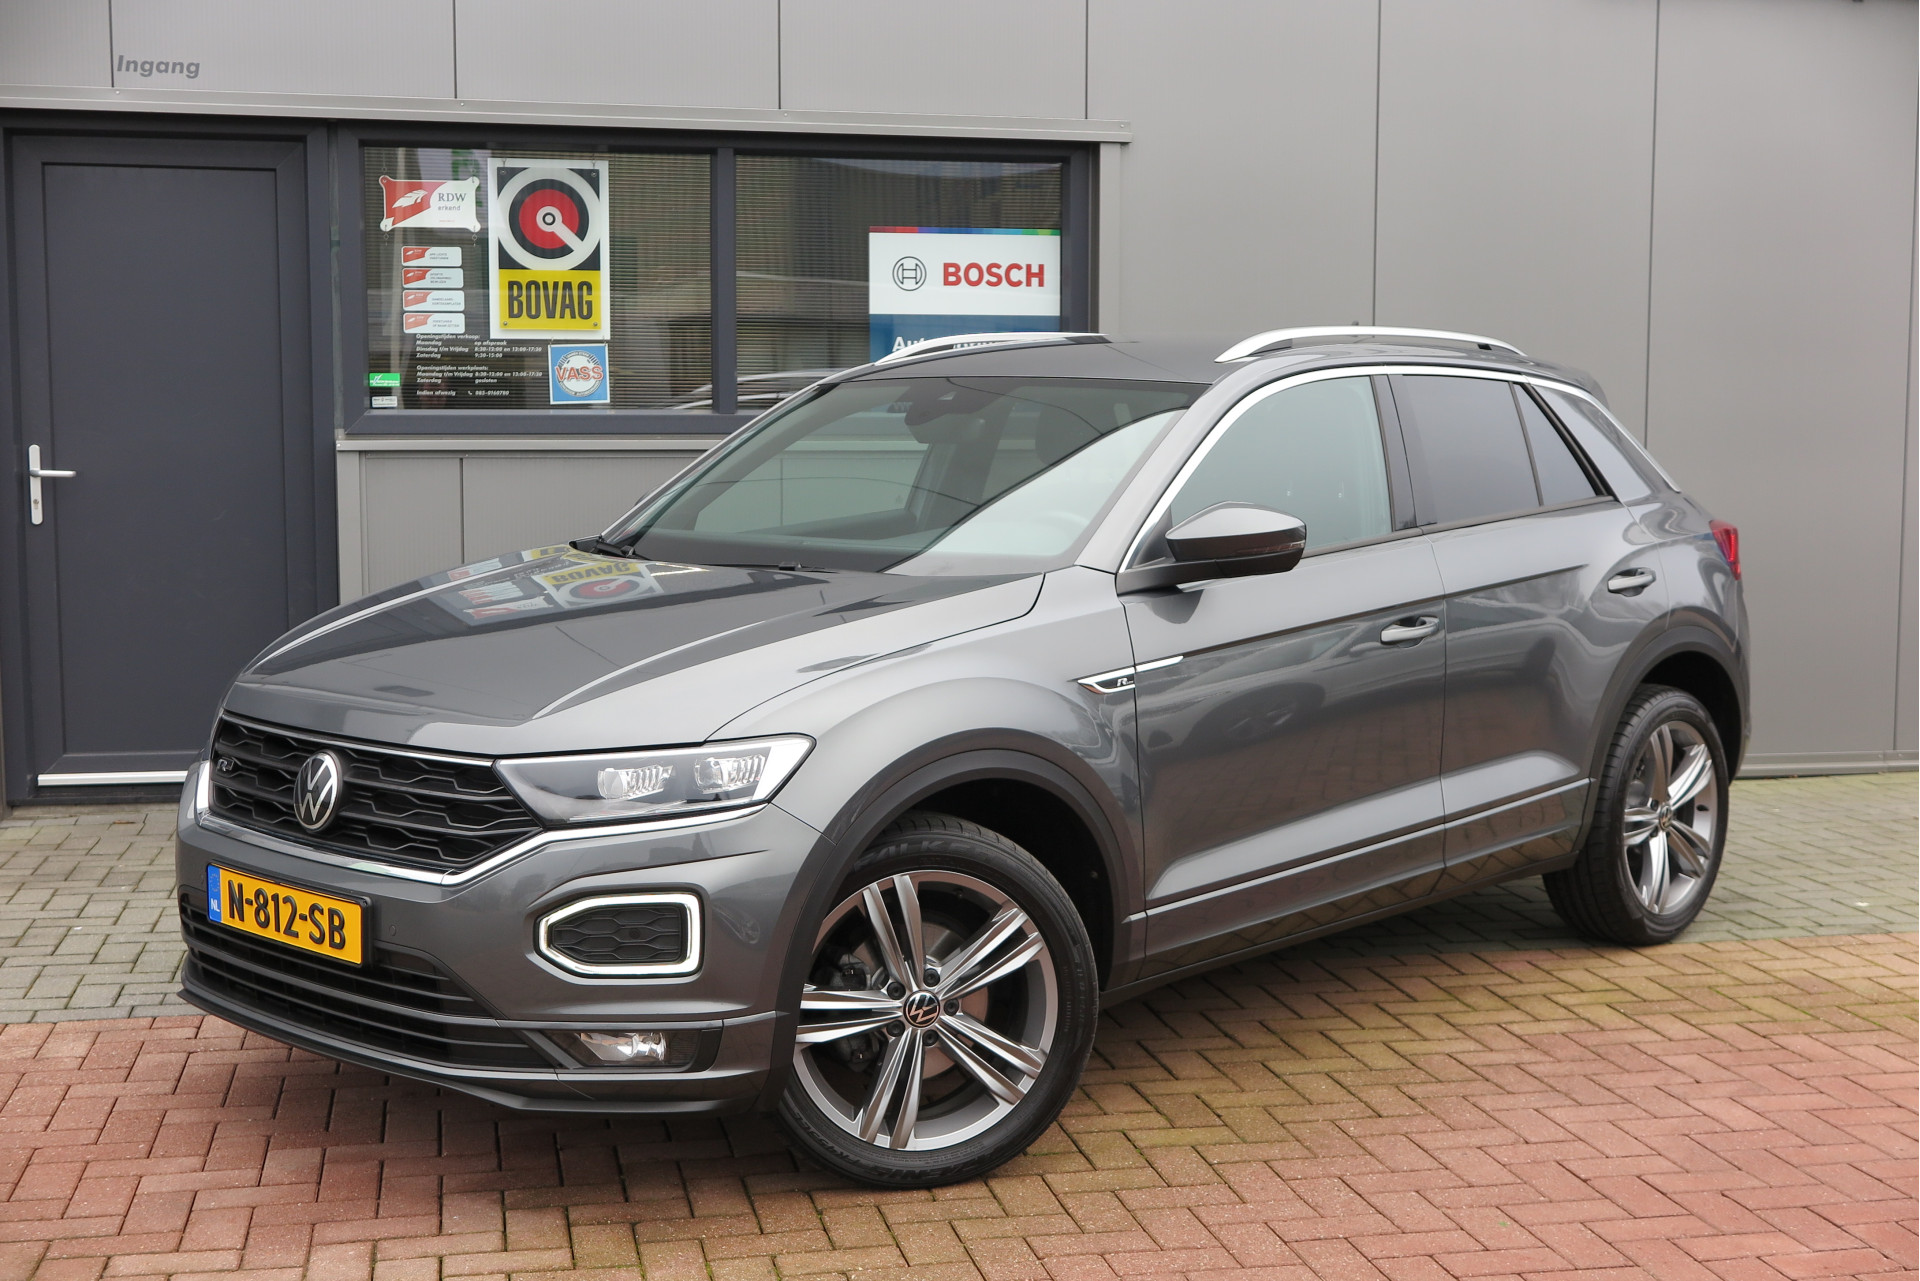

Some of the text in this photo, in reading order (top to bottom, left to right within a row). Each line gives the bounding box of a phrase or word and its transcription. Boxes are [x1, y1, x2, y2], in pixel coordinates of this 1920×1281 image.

[117, 55, 200, 79] Ingang
[438, 193, 467, 202] RDW
[943, 262, 1045, 288] BOSCH
[508, 280, 592, 320] BOVAG
[555, 365, 604, 381] VASS
[210, 898, 221, 912] NL
[228, 879, 347, 950] N-812-SB
